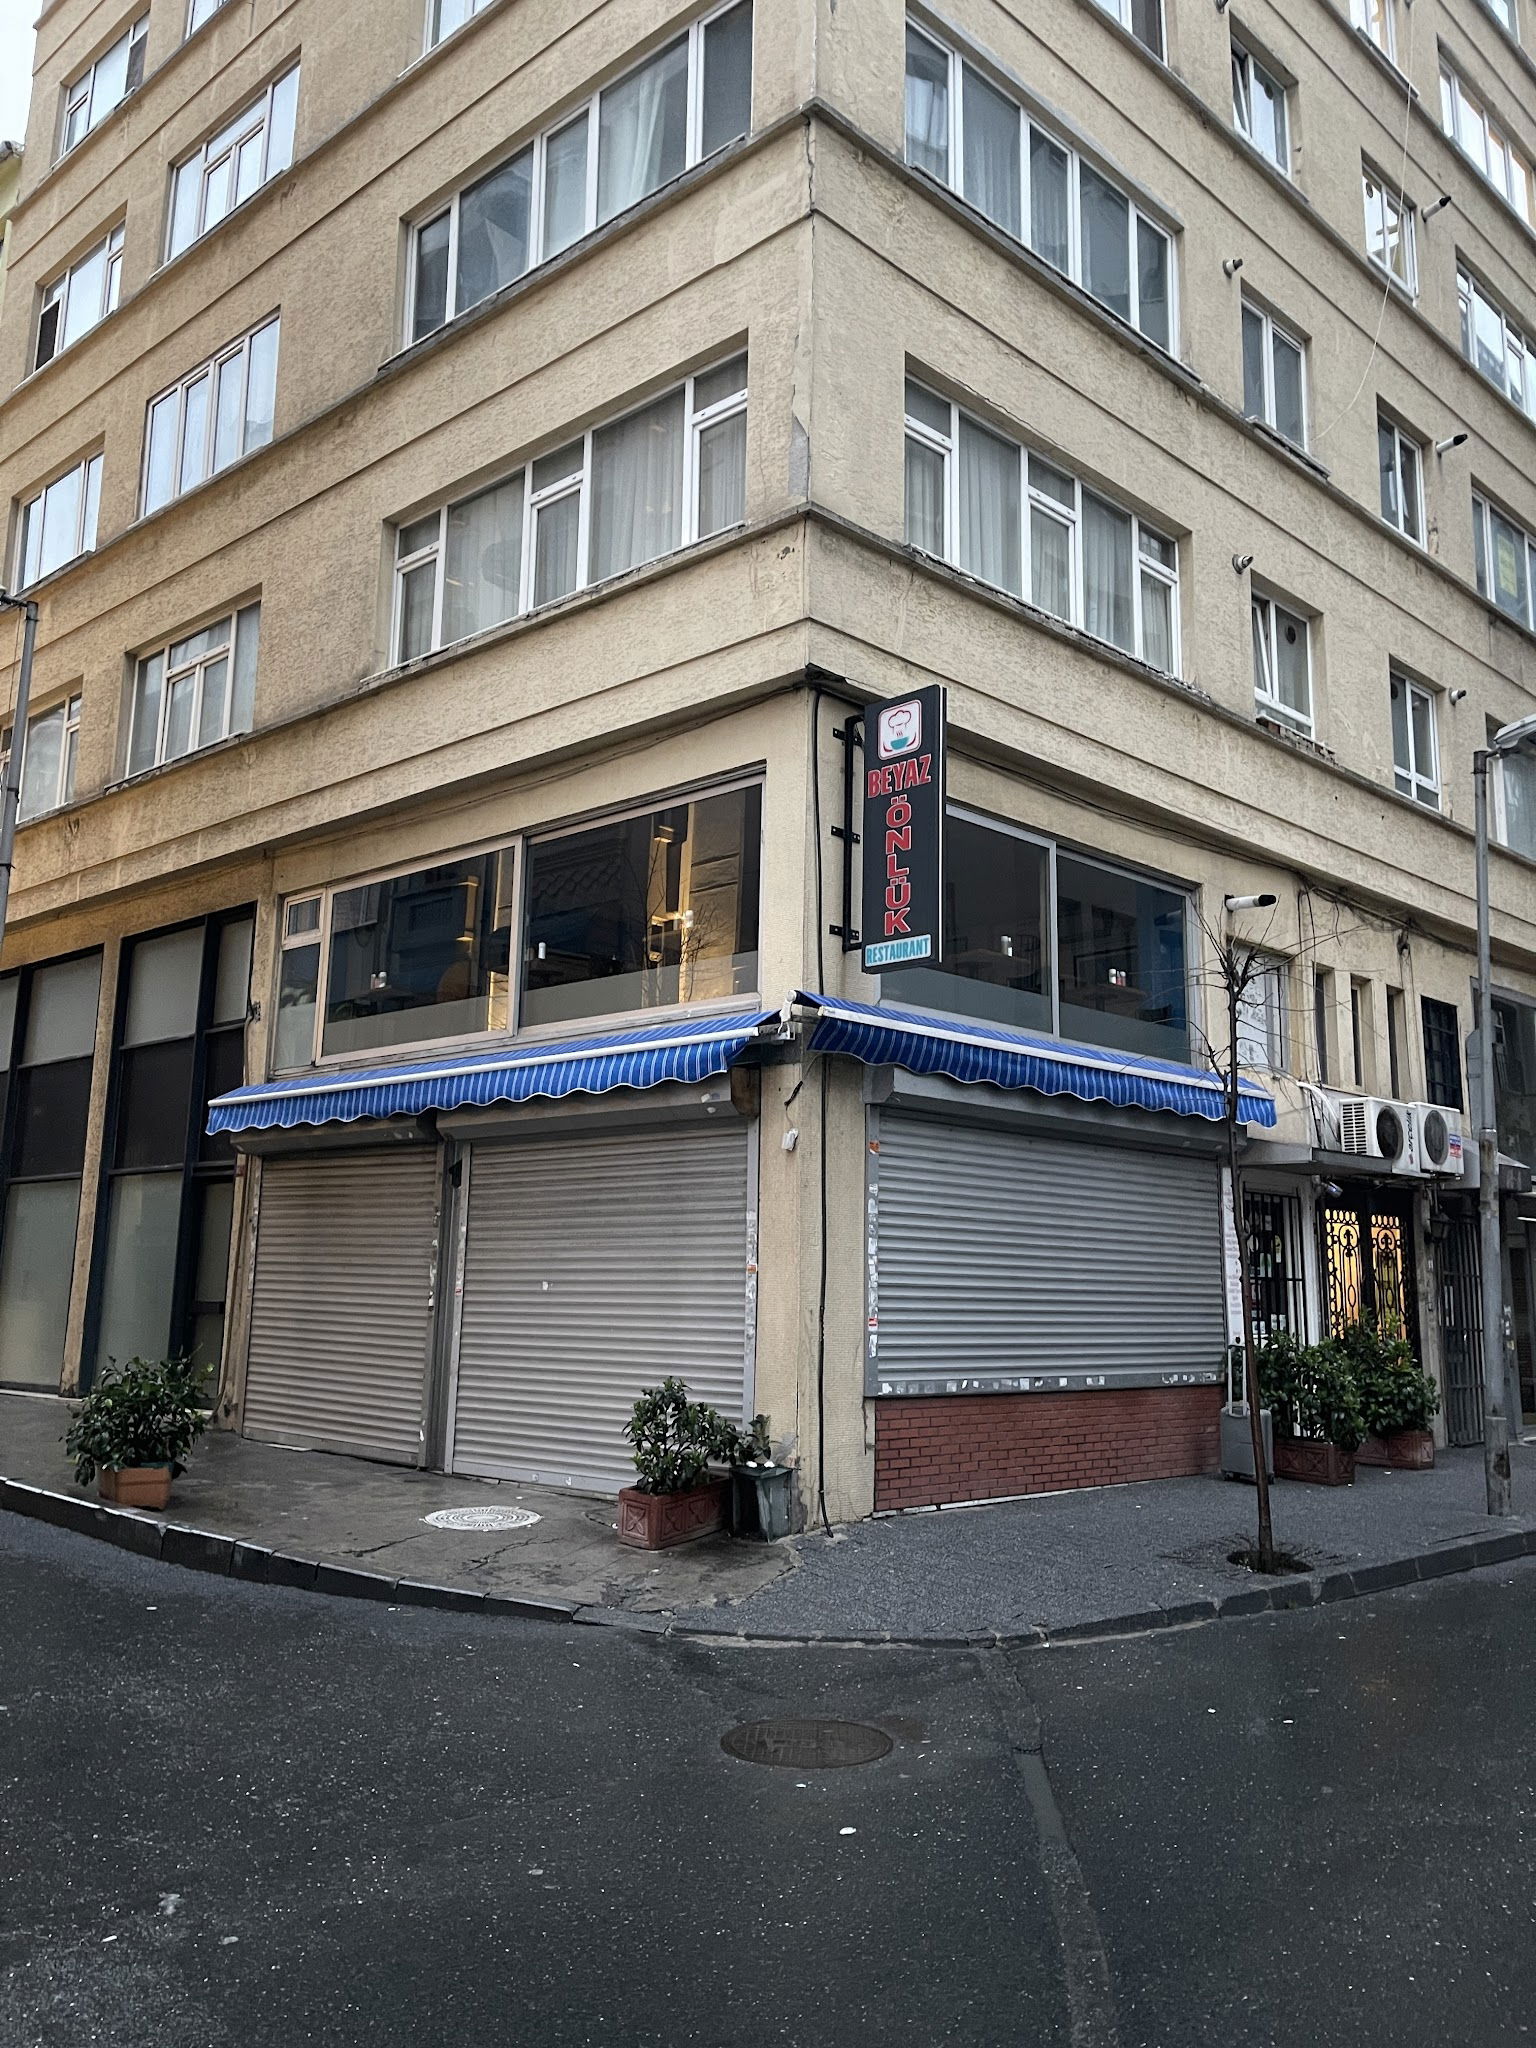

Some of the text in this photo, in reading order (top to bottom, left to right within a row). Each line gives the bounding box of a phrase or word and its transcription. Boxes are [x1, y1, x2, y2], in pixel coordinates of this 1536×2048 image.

[867, 754, 932, 798] BEYAZ
[885, 794, 912, 936] ÖNLÜK
[866, 938, 930, 964] RESTAURANT
